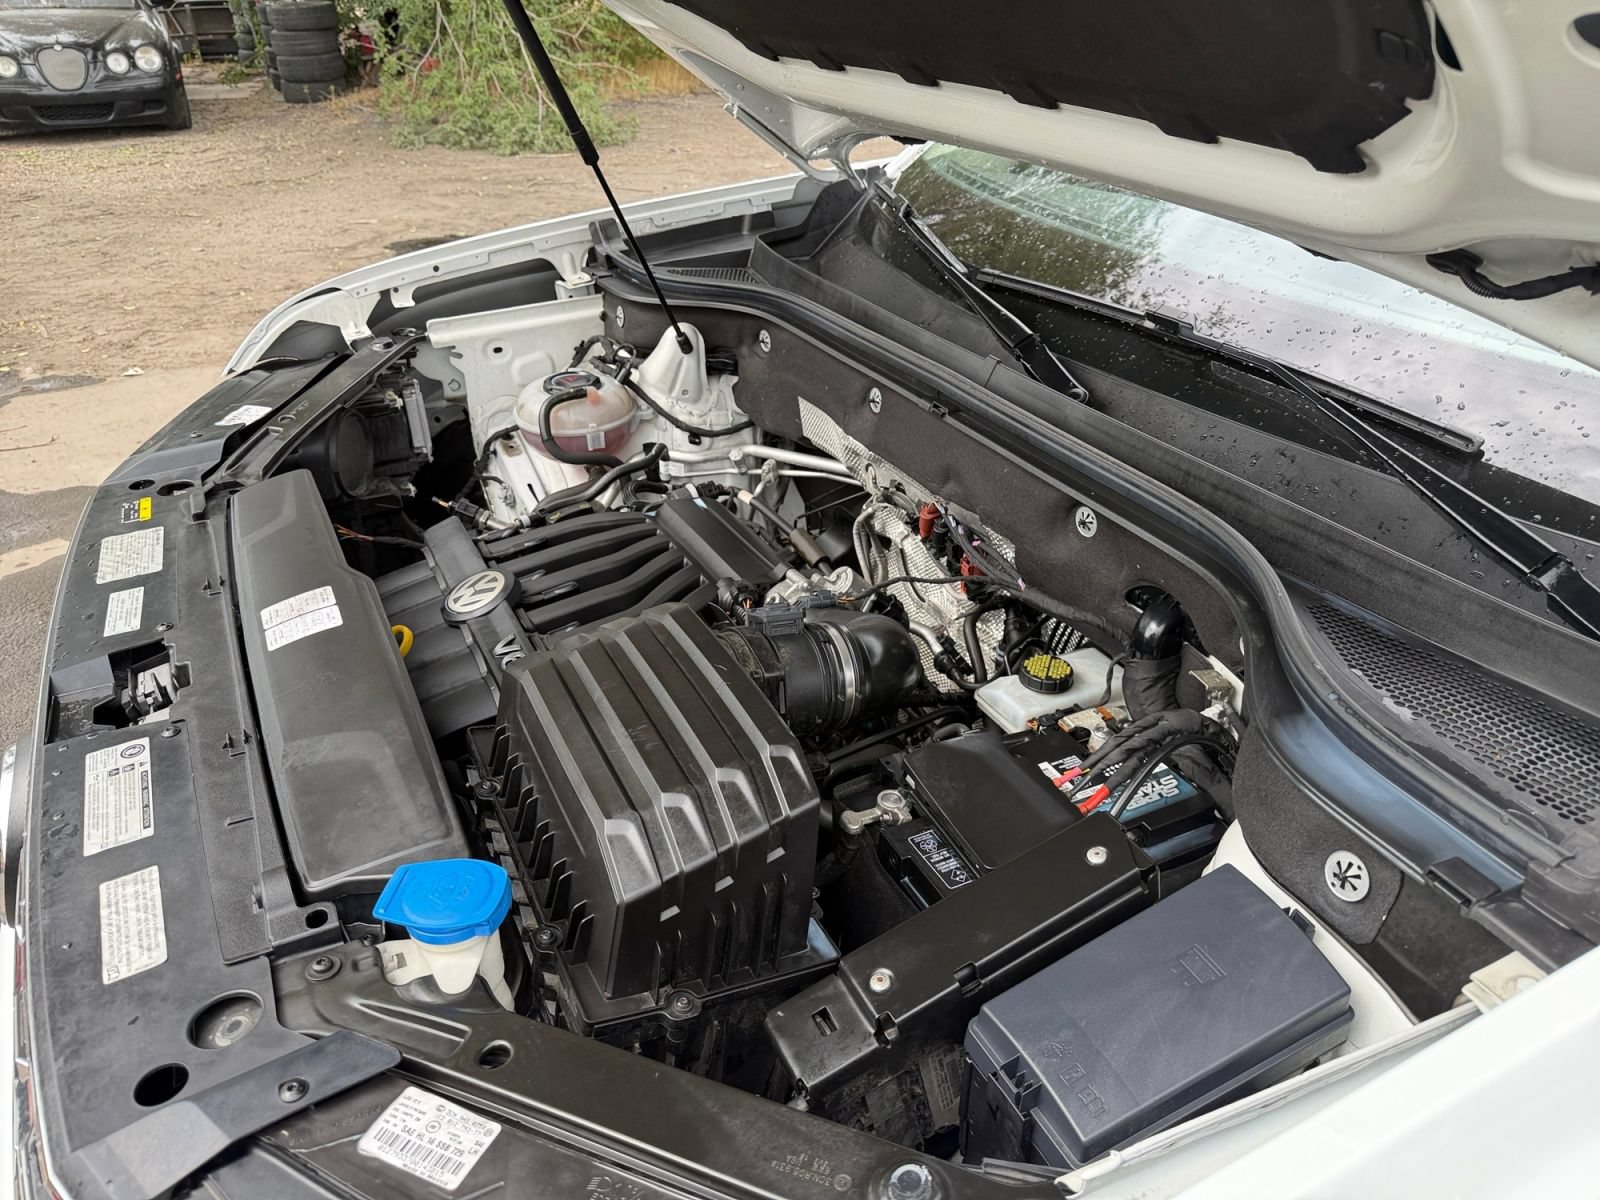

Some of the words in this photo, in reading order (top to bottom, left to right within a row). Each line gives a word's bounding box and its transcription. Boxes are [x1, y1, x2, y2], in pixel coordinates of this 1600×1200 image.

[400, 1124, 417, 1137] SAE
[415, 1131, 425, 1142] HL
[427, 1136, 437, 1145] 16
